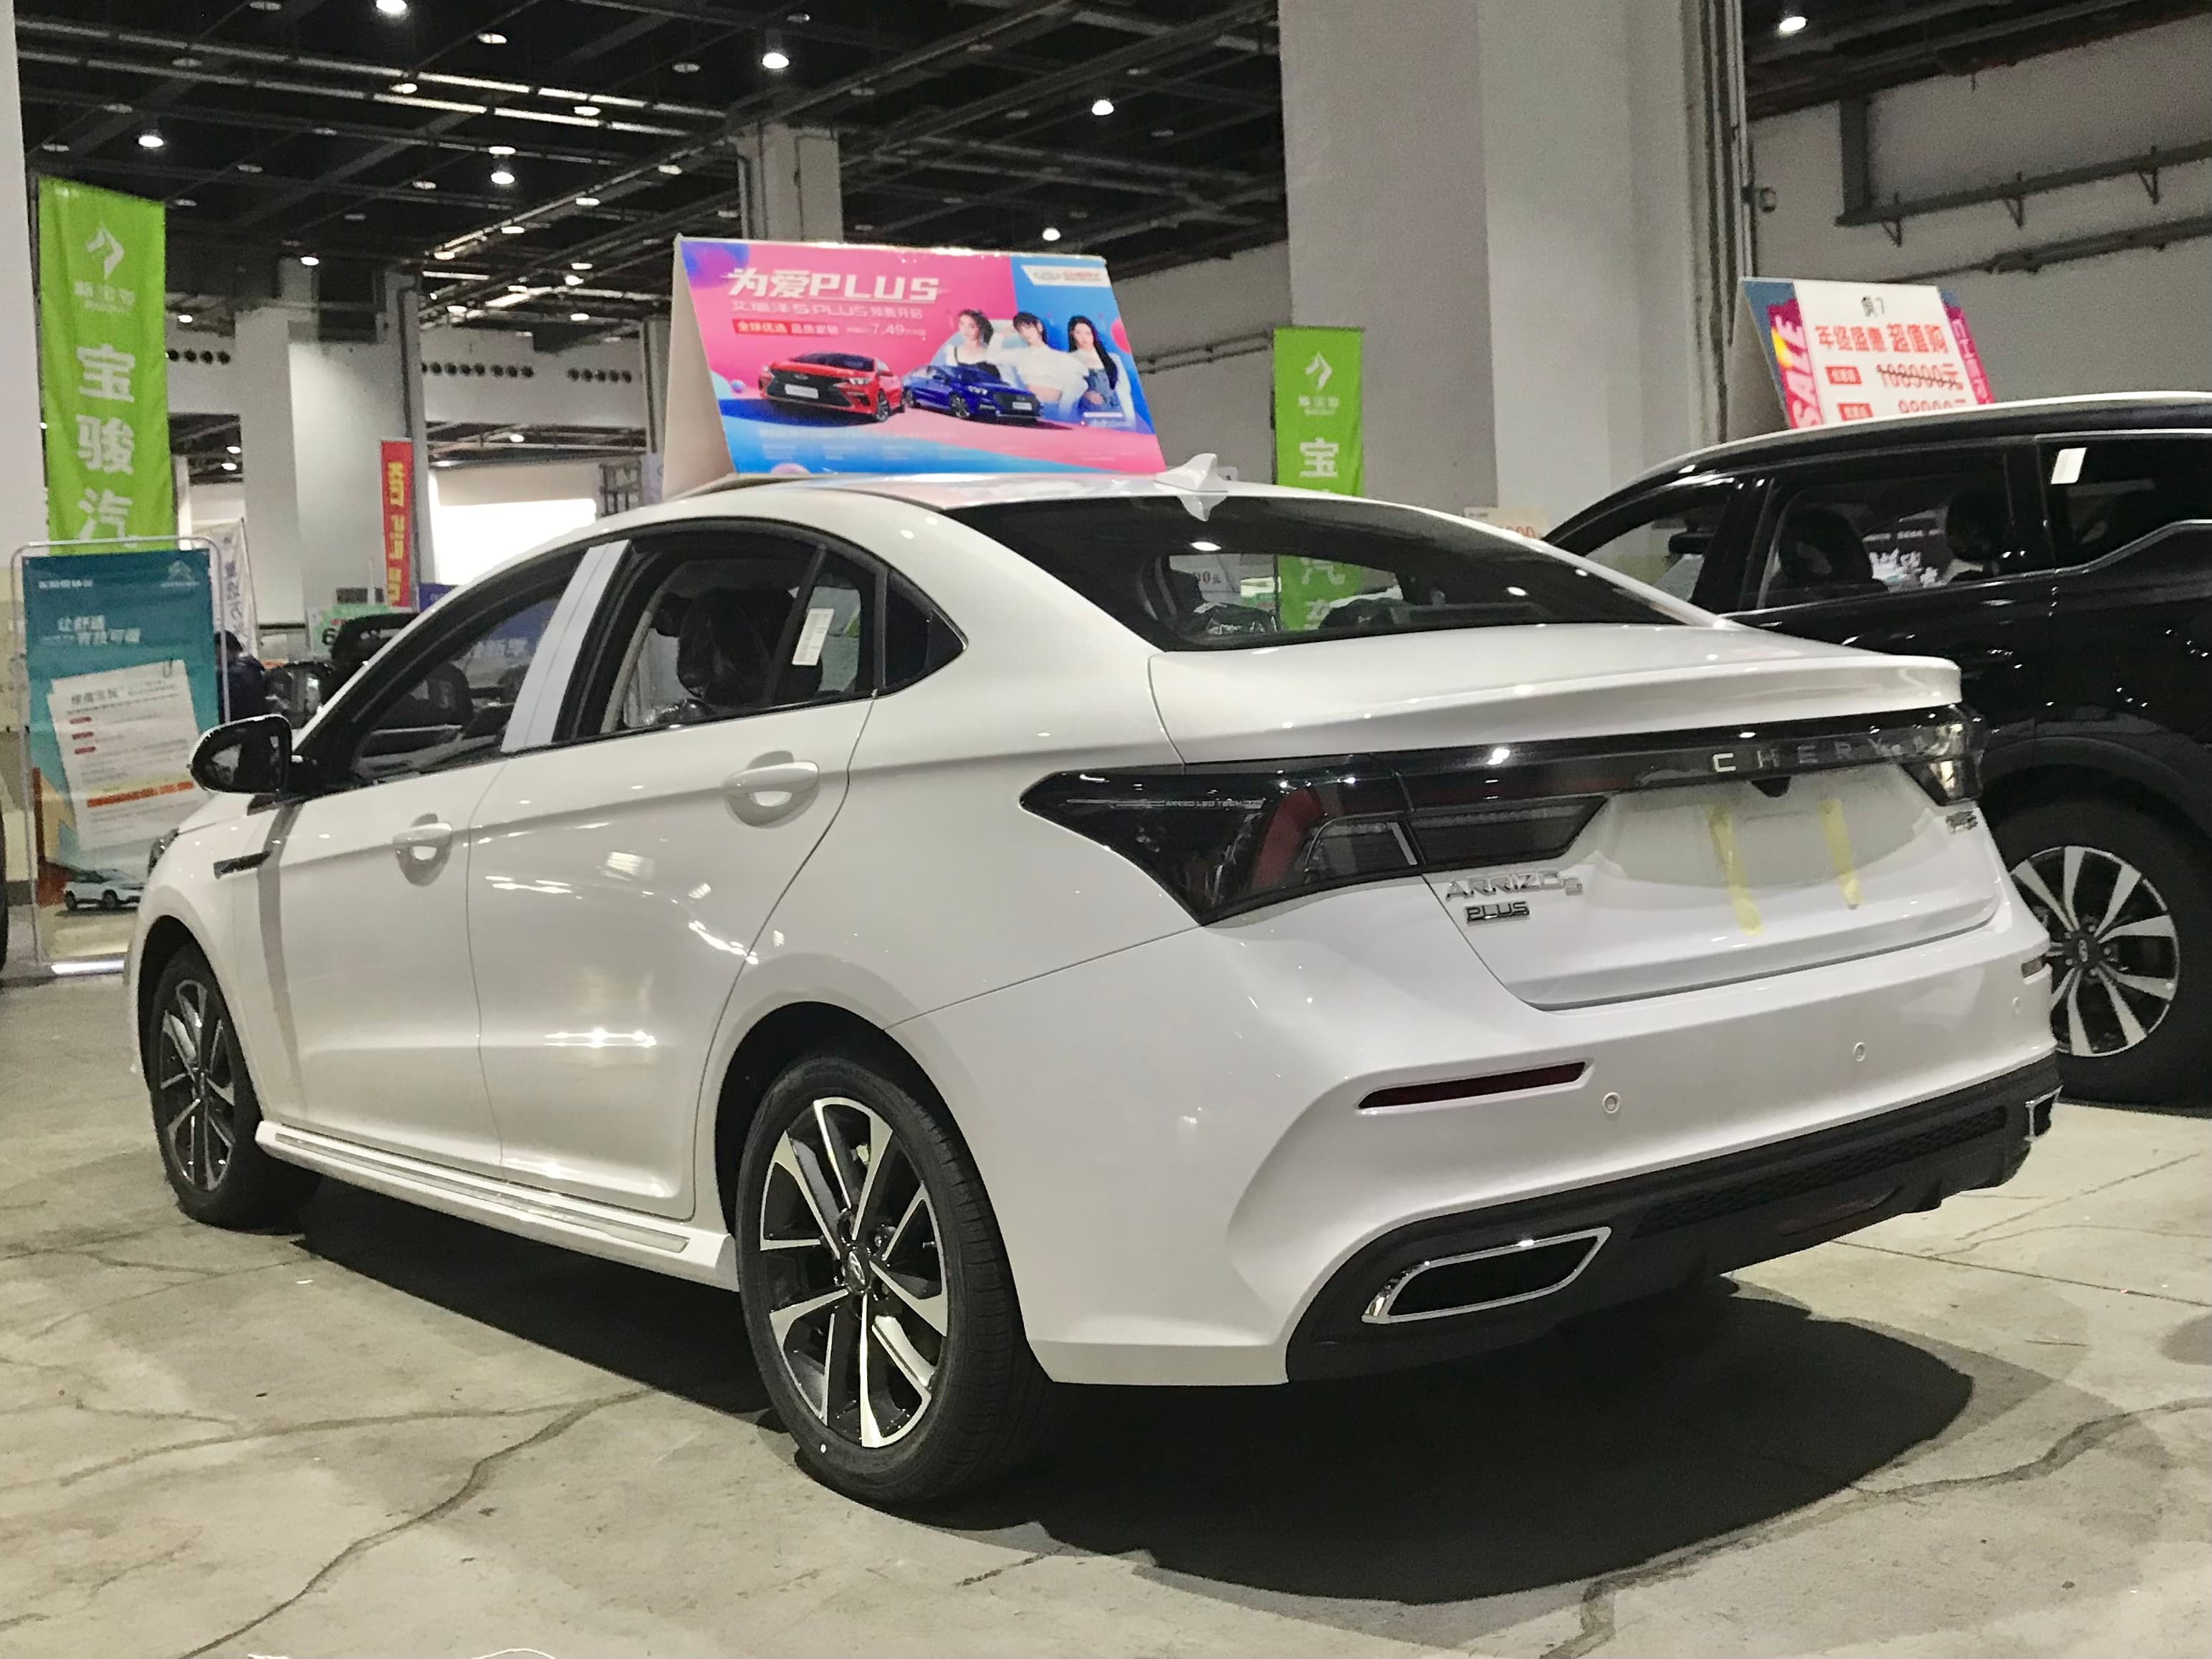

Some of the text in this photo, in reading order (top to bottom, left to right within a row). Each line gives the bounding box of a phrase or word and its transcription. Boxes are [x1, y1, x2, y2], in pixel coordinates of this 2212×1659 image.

[727, 268, 939, 301] 为爱PLUS
[813, 303, 868, 317] PLUS
[1712, 737, 1884, 773] CHERY
[1465, 901, 1531, 925] PLUS
